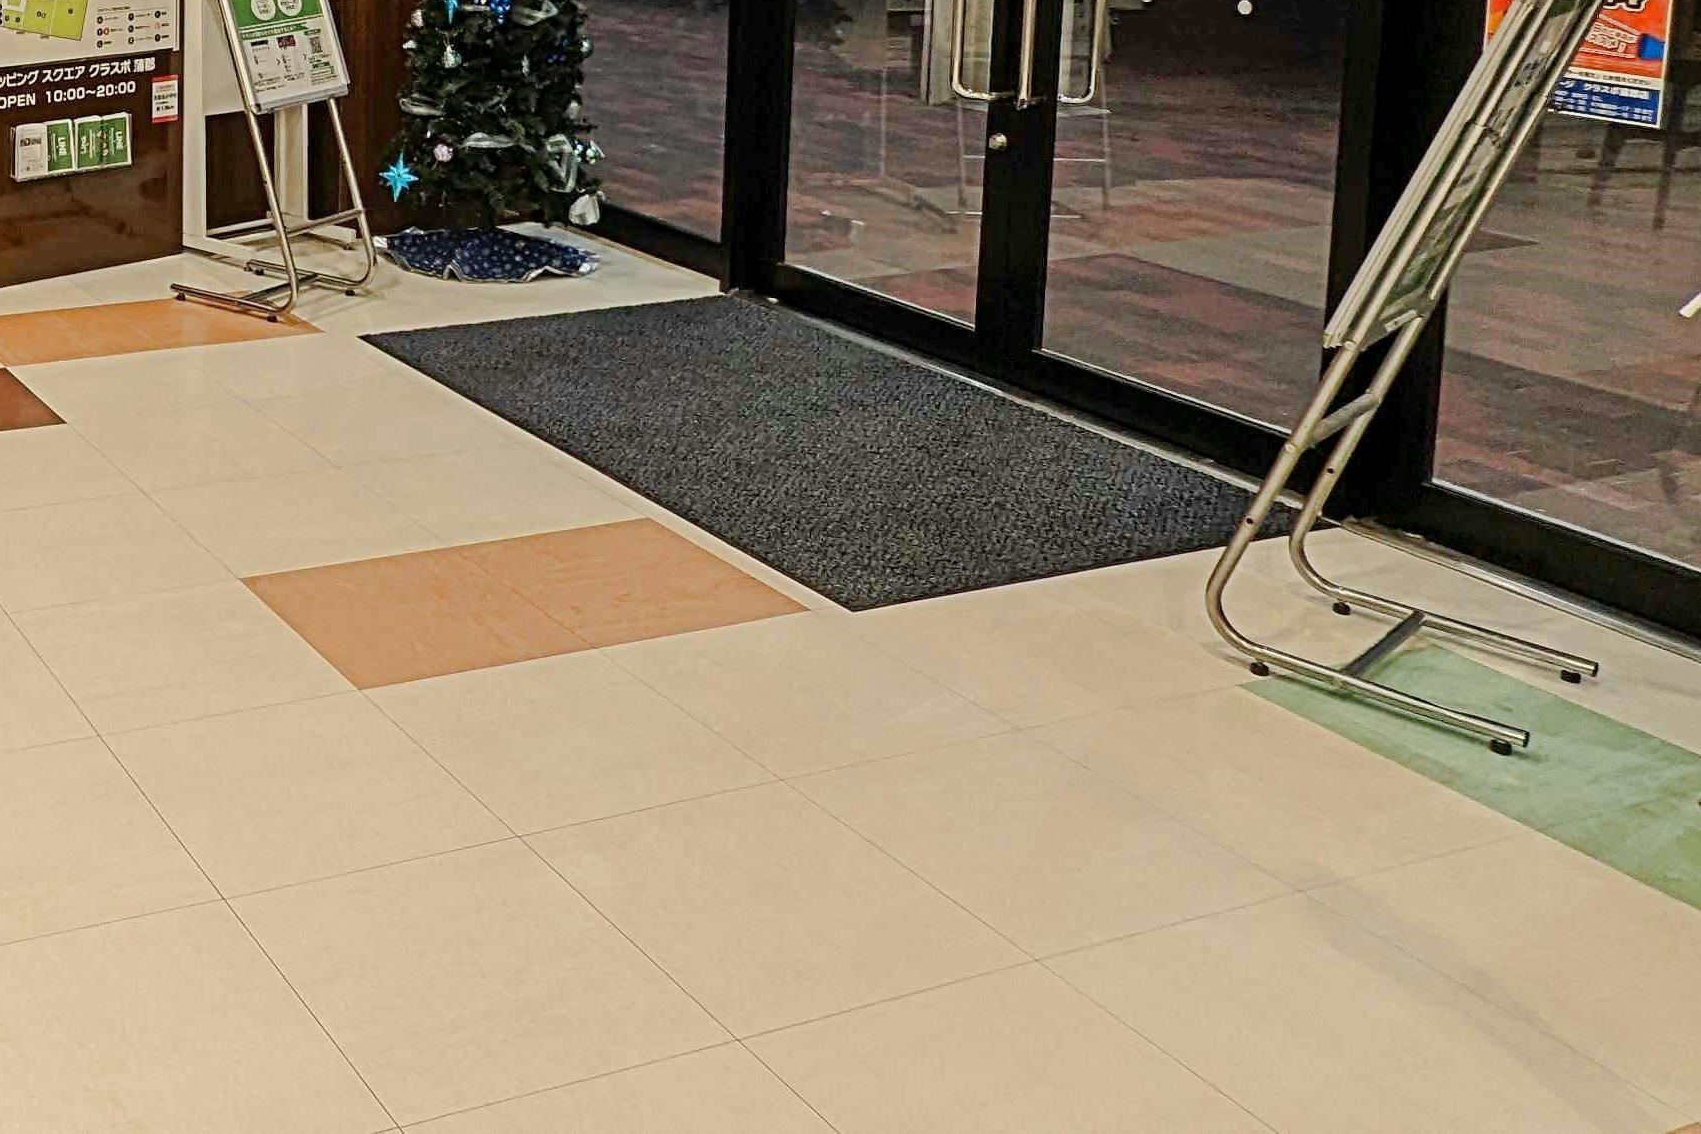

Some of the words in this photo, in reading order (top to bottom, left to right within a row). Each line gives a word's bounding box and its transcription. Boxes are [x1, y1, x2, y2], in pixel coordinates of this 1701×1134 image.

[42, 66, 86, 84] スクエア
[89, 59, 131, 77] クラスポ
